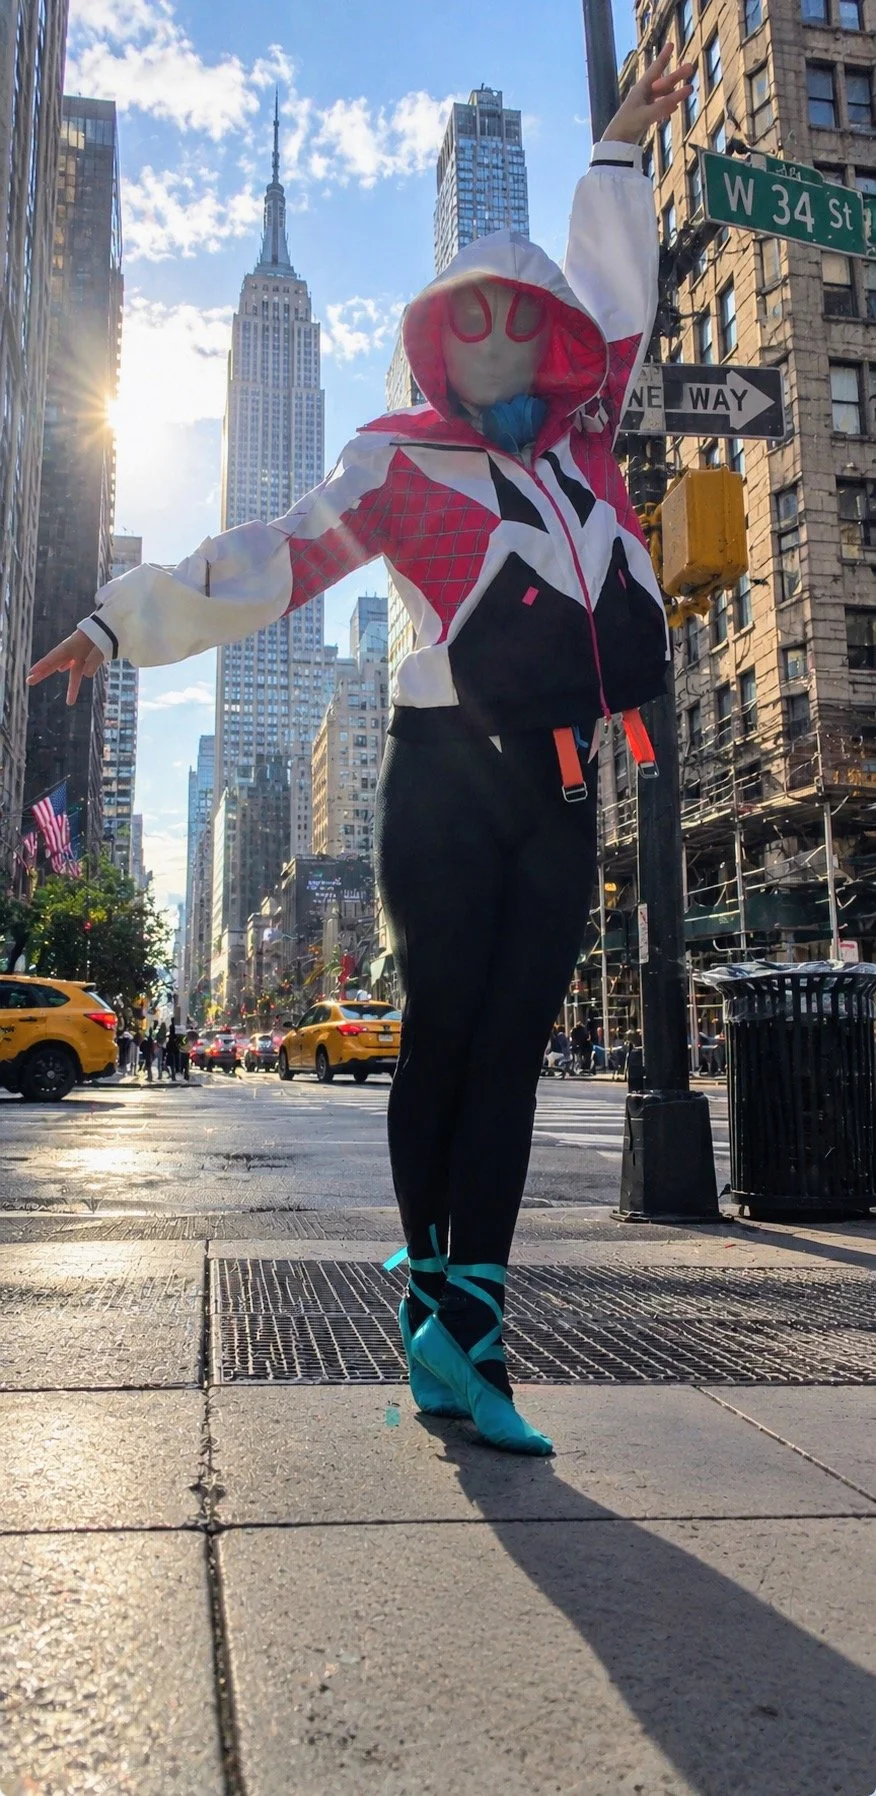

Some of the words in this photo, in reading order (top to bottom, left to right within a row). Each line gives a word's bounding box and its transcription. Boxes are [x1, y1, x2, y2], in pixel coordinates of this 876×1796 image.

[724, 172, 754, 216] W
[771, 184, 815, 233] 34
[829, 198, 853, 230] St
[627, 386, 662, 409] NE
[689, 387, 748, 411] WAY
